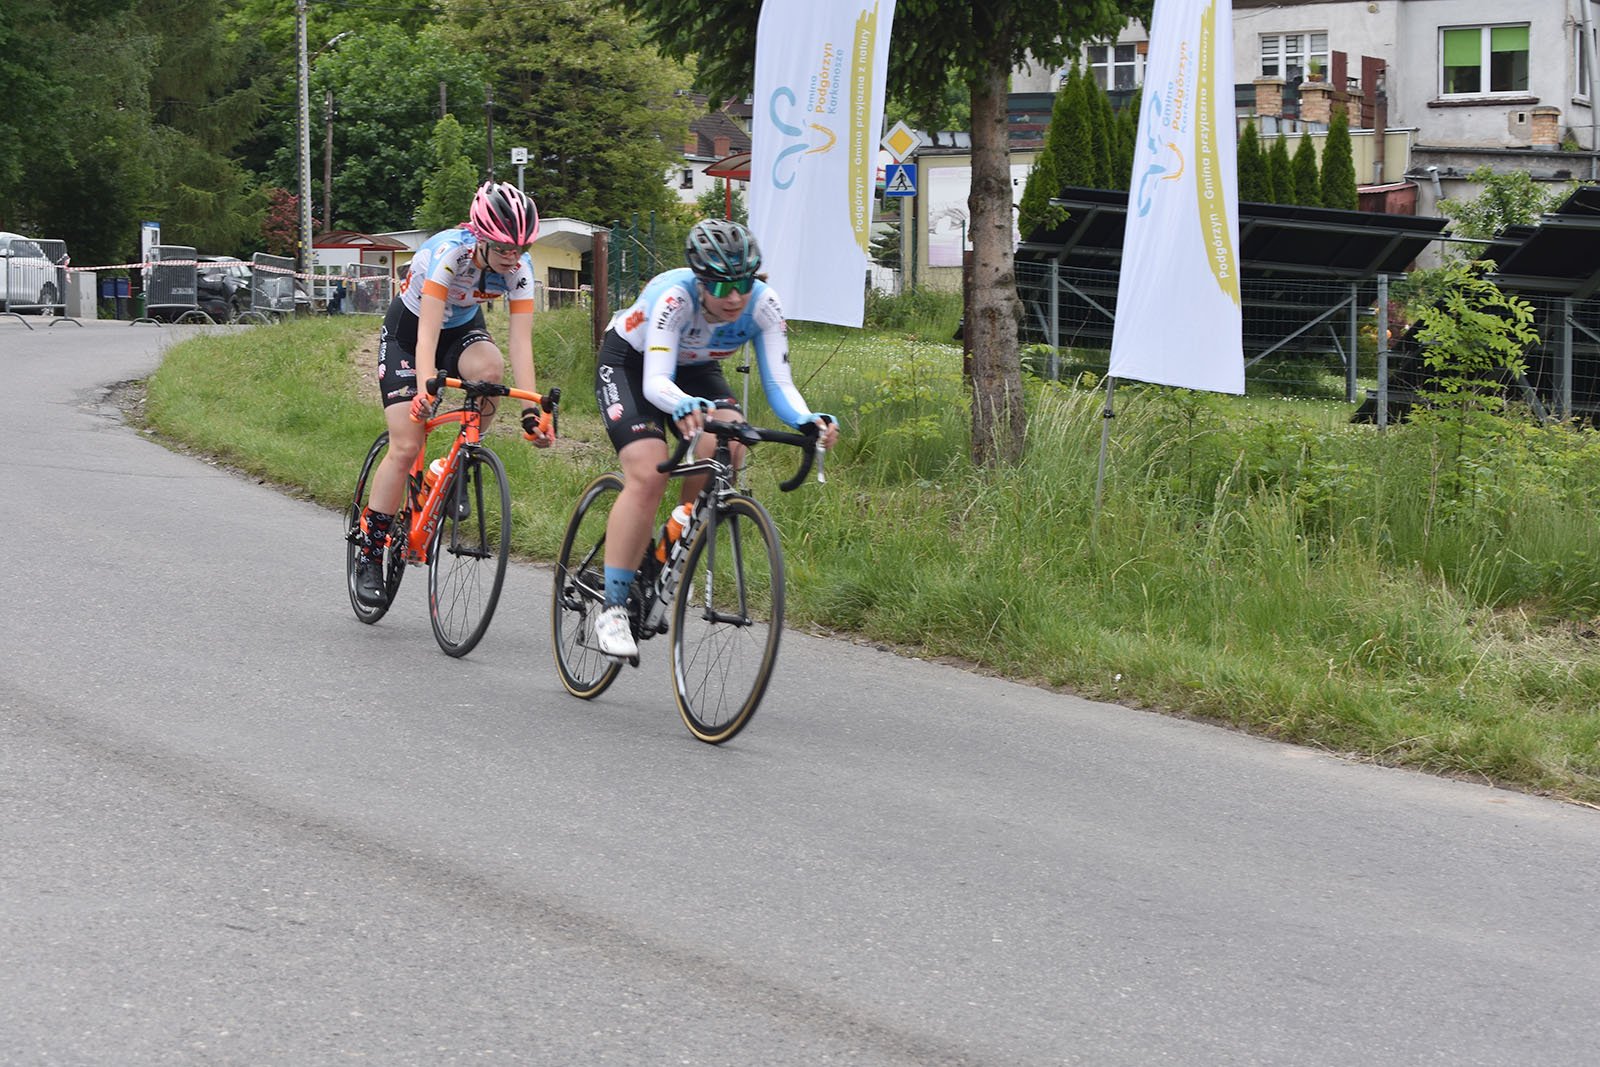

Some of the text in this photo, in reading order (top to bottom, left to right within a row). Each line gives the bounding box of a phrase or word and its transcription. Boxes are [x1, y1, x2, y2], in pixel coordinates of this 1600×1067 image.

[859, 28, 871, 63] natury
[806, 75, 817, 112] Gmina
[815, 42, 833, 114] Podgórzyn
[827, 48, 844, 115] Karkonosze
[856, 75, 865, 127] przyjazna
[1162, 81, 1174, 127] Gmina
[1171, 40, 1188, 131] Podgórzyn
[854, 130, 864, 165] Gmina
[1200, 88, 1211, 154] przyjazna
[855, 176, 865, 232] Podgórzyn
[1203, 157, 1214, 200] Gmina
[1211, 213, 1229, 278] Podgórzyn
